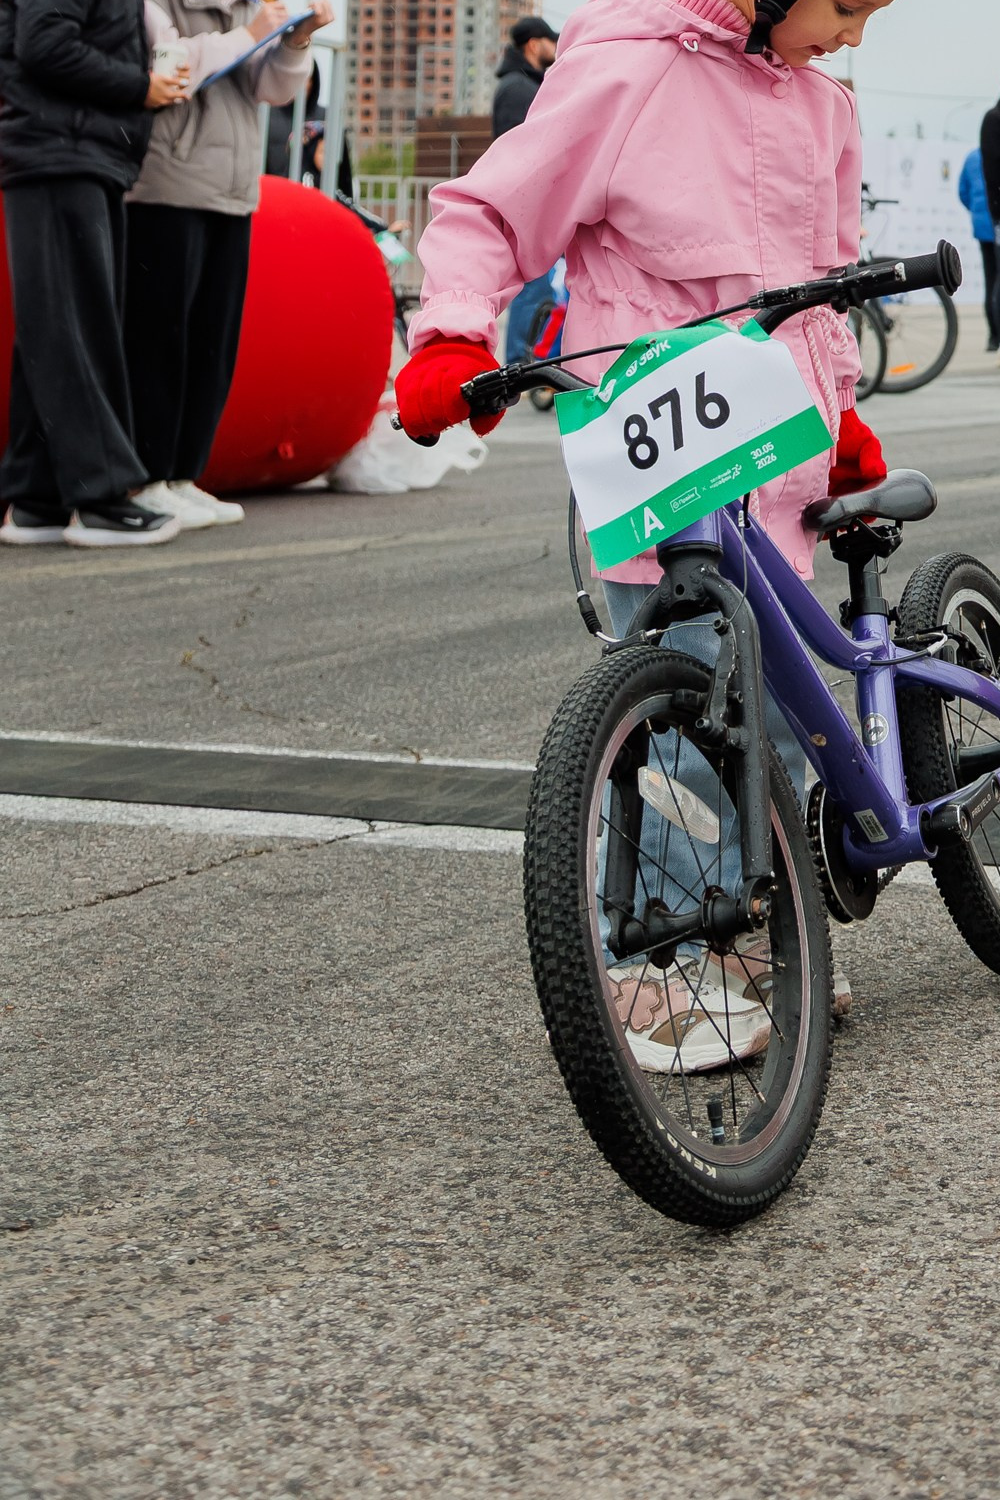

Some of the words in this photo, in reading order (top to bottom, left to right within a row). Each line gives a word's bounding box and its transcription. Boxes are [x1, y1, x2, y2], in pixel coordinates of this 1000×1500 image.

[623, 371, 730, 470] 876
[750, 441, 775, 460] 30.05
[755, 452, 778, 470] 2026
